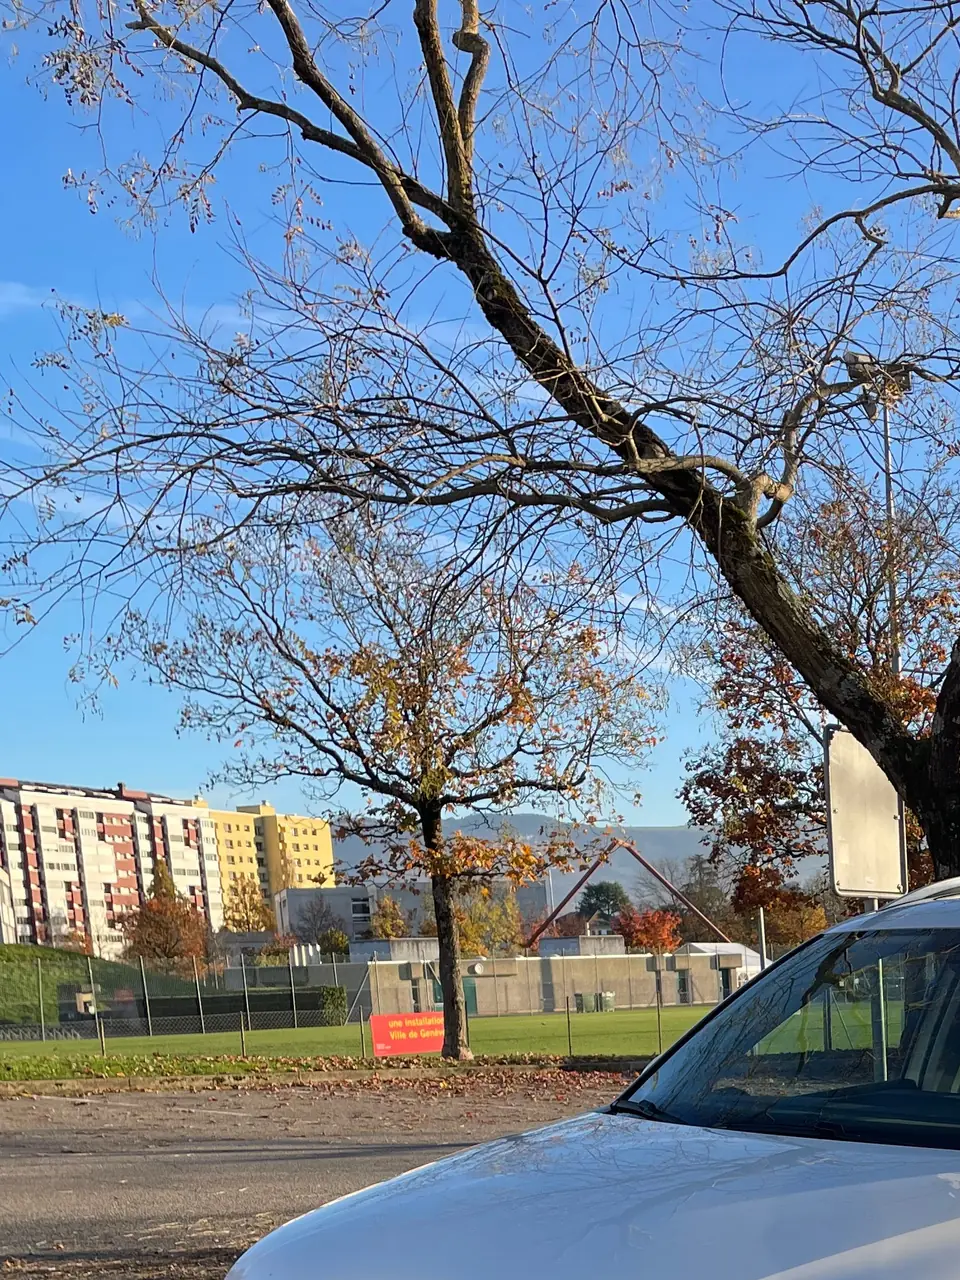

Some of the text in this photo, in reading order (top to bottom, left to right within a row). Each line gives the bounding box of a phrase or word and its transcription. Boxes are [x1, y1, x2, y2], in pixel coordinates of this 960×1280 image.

[388, 1020, 403, 1028] une
[389, 1028, 445, 1040] Ville de Genèv
